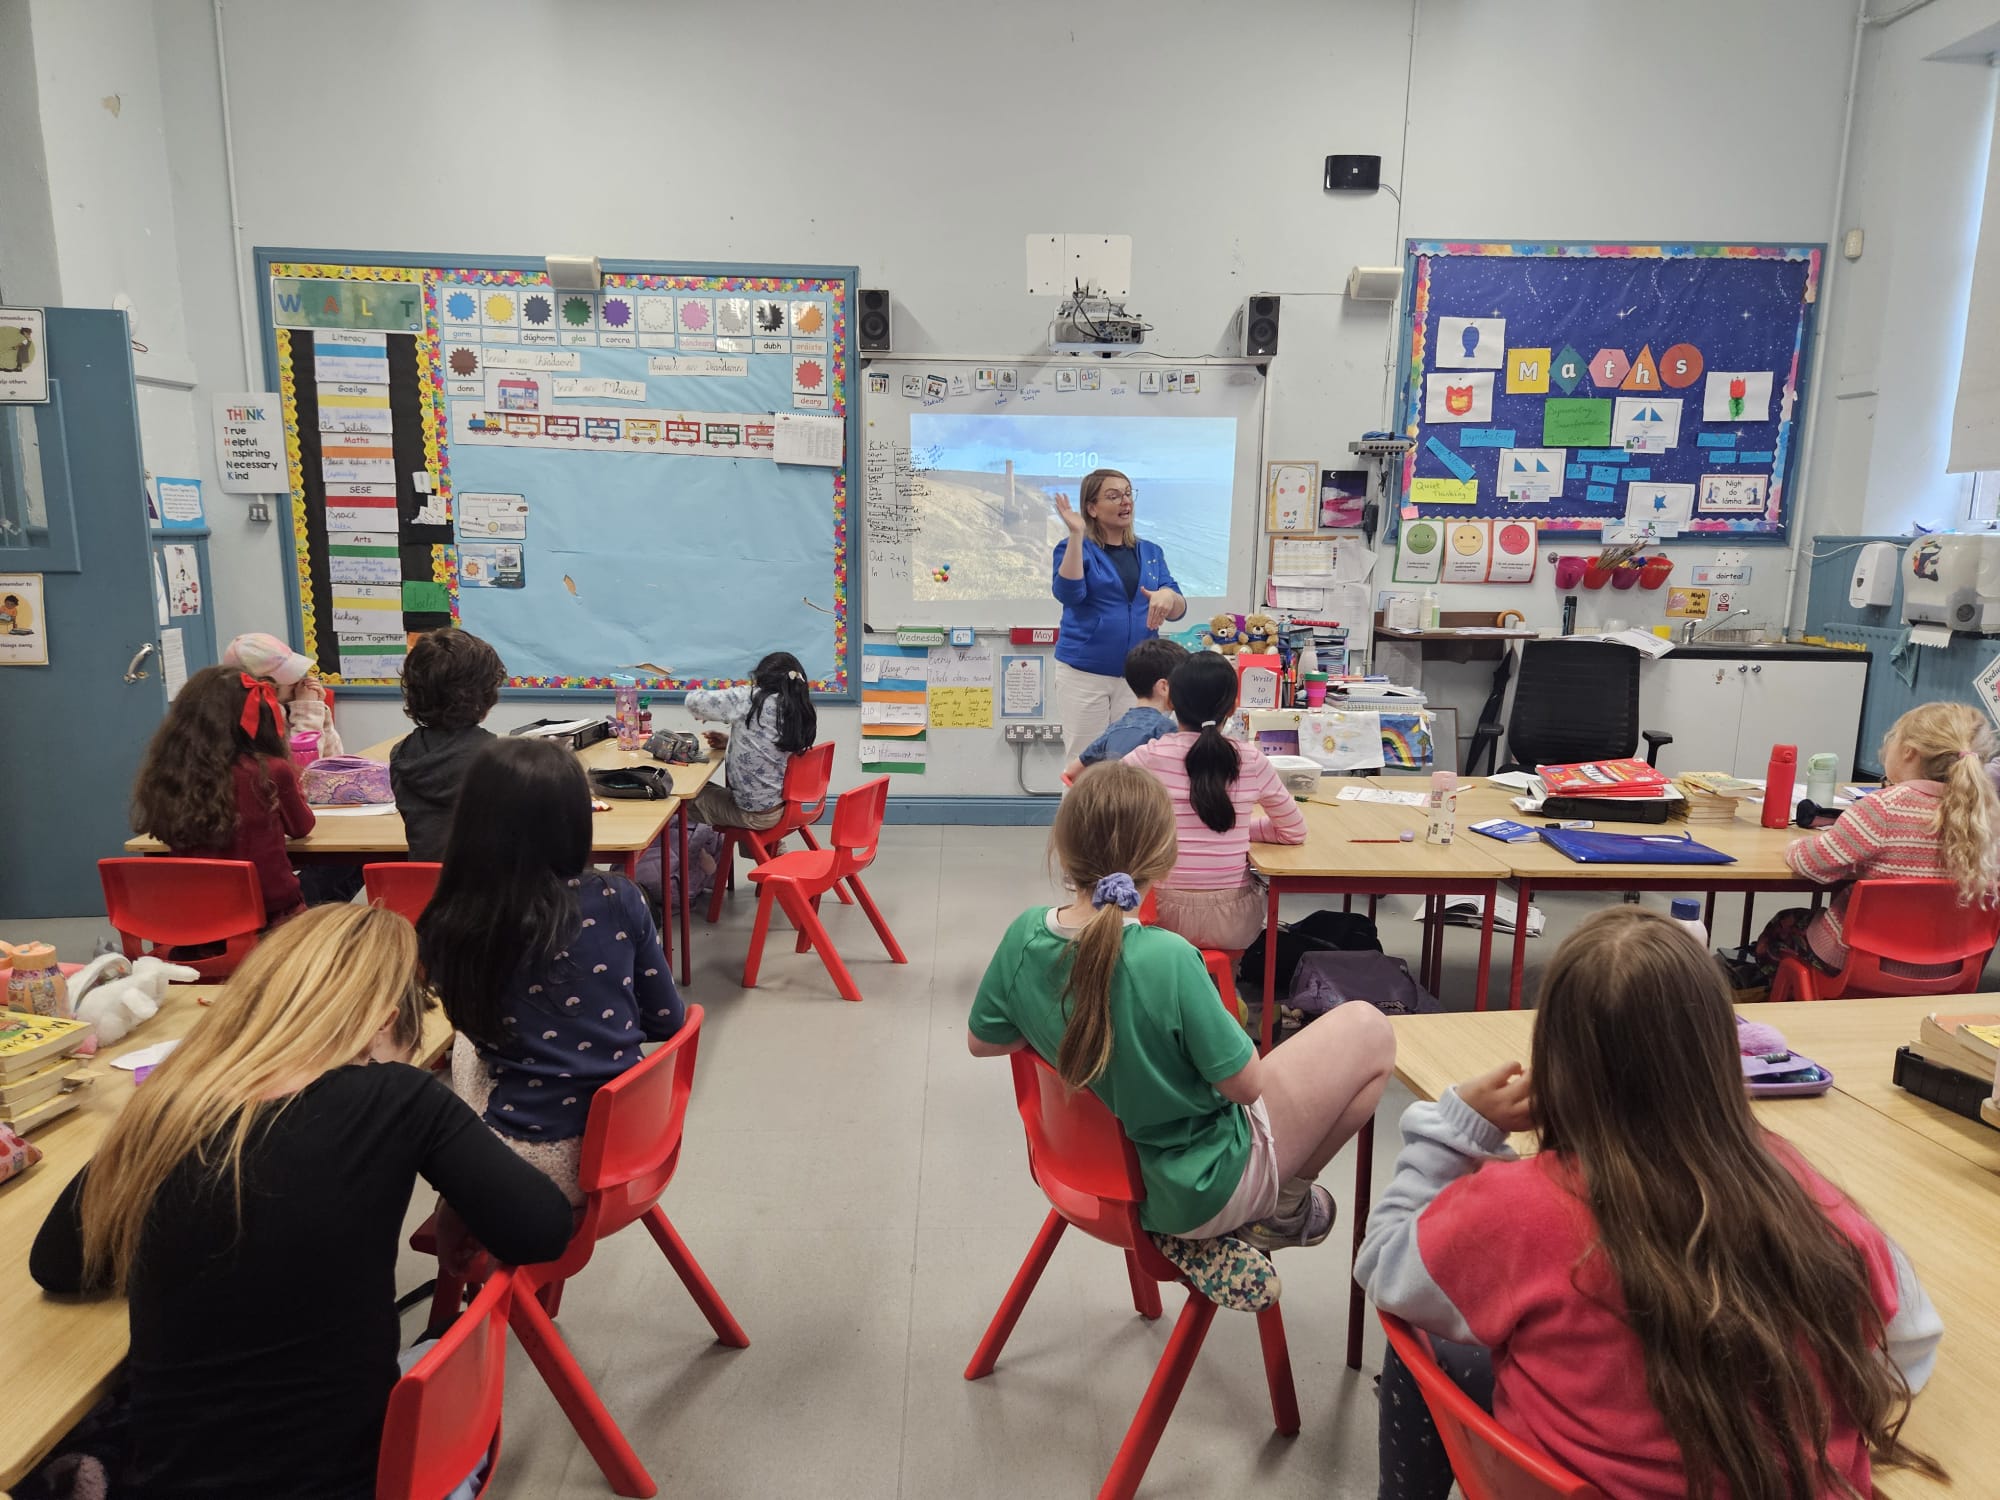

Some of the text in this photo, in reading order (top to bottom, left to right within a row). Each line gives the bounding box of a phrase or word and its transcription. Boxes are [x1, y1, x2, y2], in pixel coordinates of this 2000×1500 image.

[332, 333, 367, 344] Literacy
[571, 335, 587, 343] glas
[606, 336, 630, 344] corcra
[764, 342, 782, 350] dubh
[1518, 359, 1688, 384] Maths
[337, 385, 368, 395] Gaeilge
[457, 384, 475, 392] donn
[800, 398, 822, 407] dearg
[226, 408, 265, 421] THINK
[224, 438, 258, 448] Helpful
[344, 436, 370, 445] Maths
[226, 449, 271, 459] Inspiring
[1054, 452, 1099, 469] 12:10
[227, 461, 279, 471] Necessary
[227, 472, 250, 480] Kind
[349, 485, 373, 494] SESE
[353, 535, 372, 543] Arts
[357, 587, 375, 596] P.E.
[341, 634, 403, 643] Learn Together
[898, 633, 945, 643] Wednesday
[955, 632, 970, 642] 6th
[1033, 631, 1053, 643] May
[1249, 696, 1272, 706] Right
